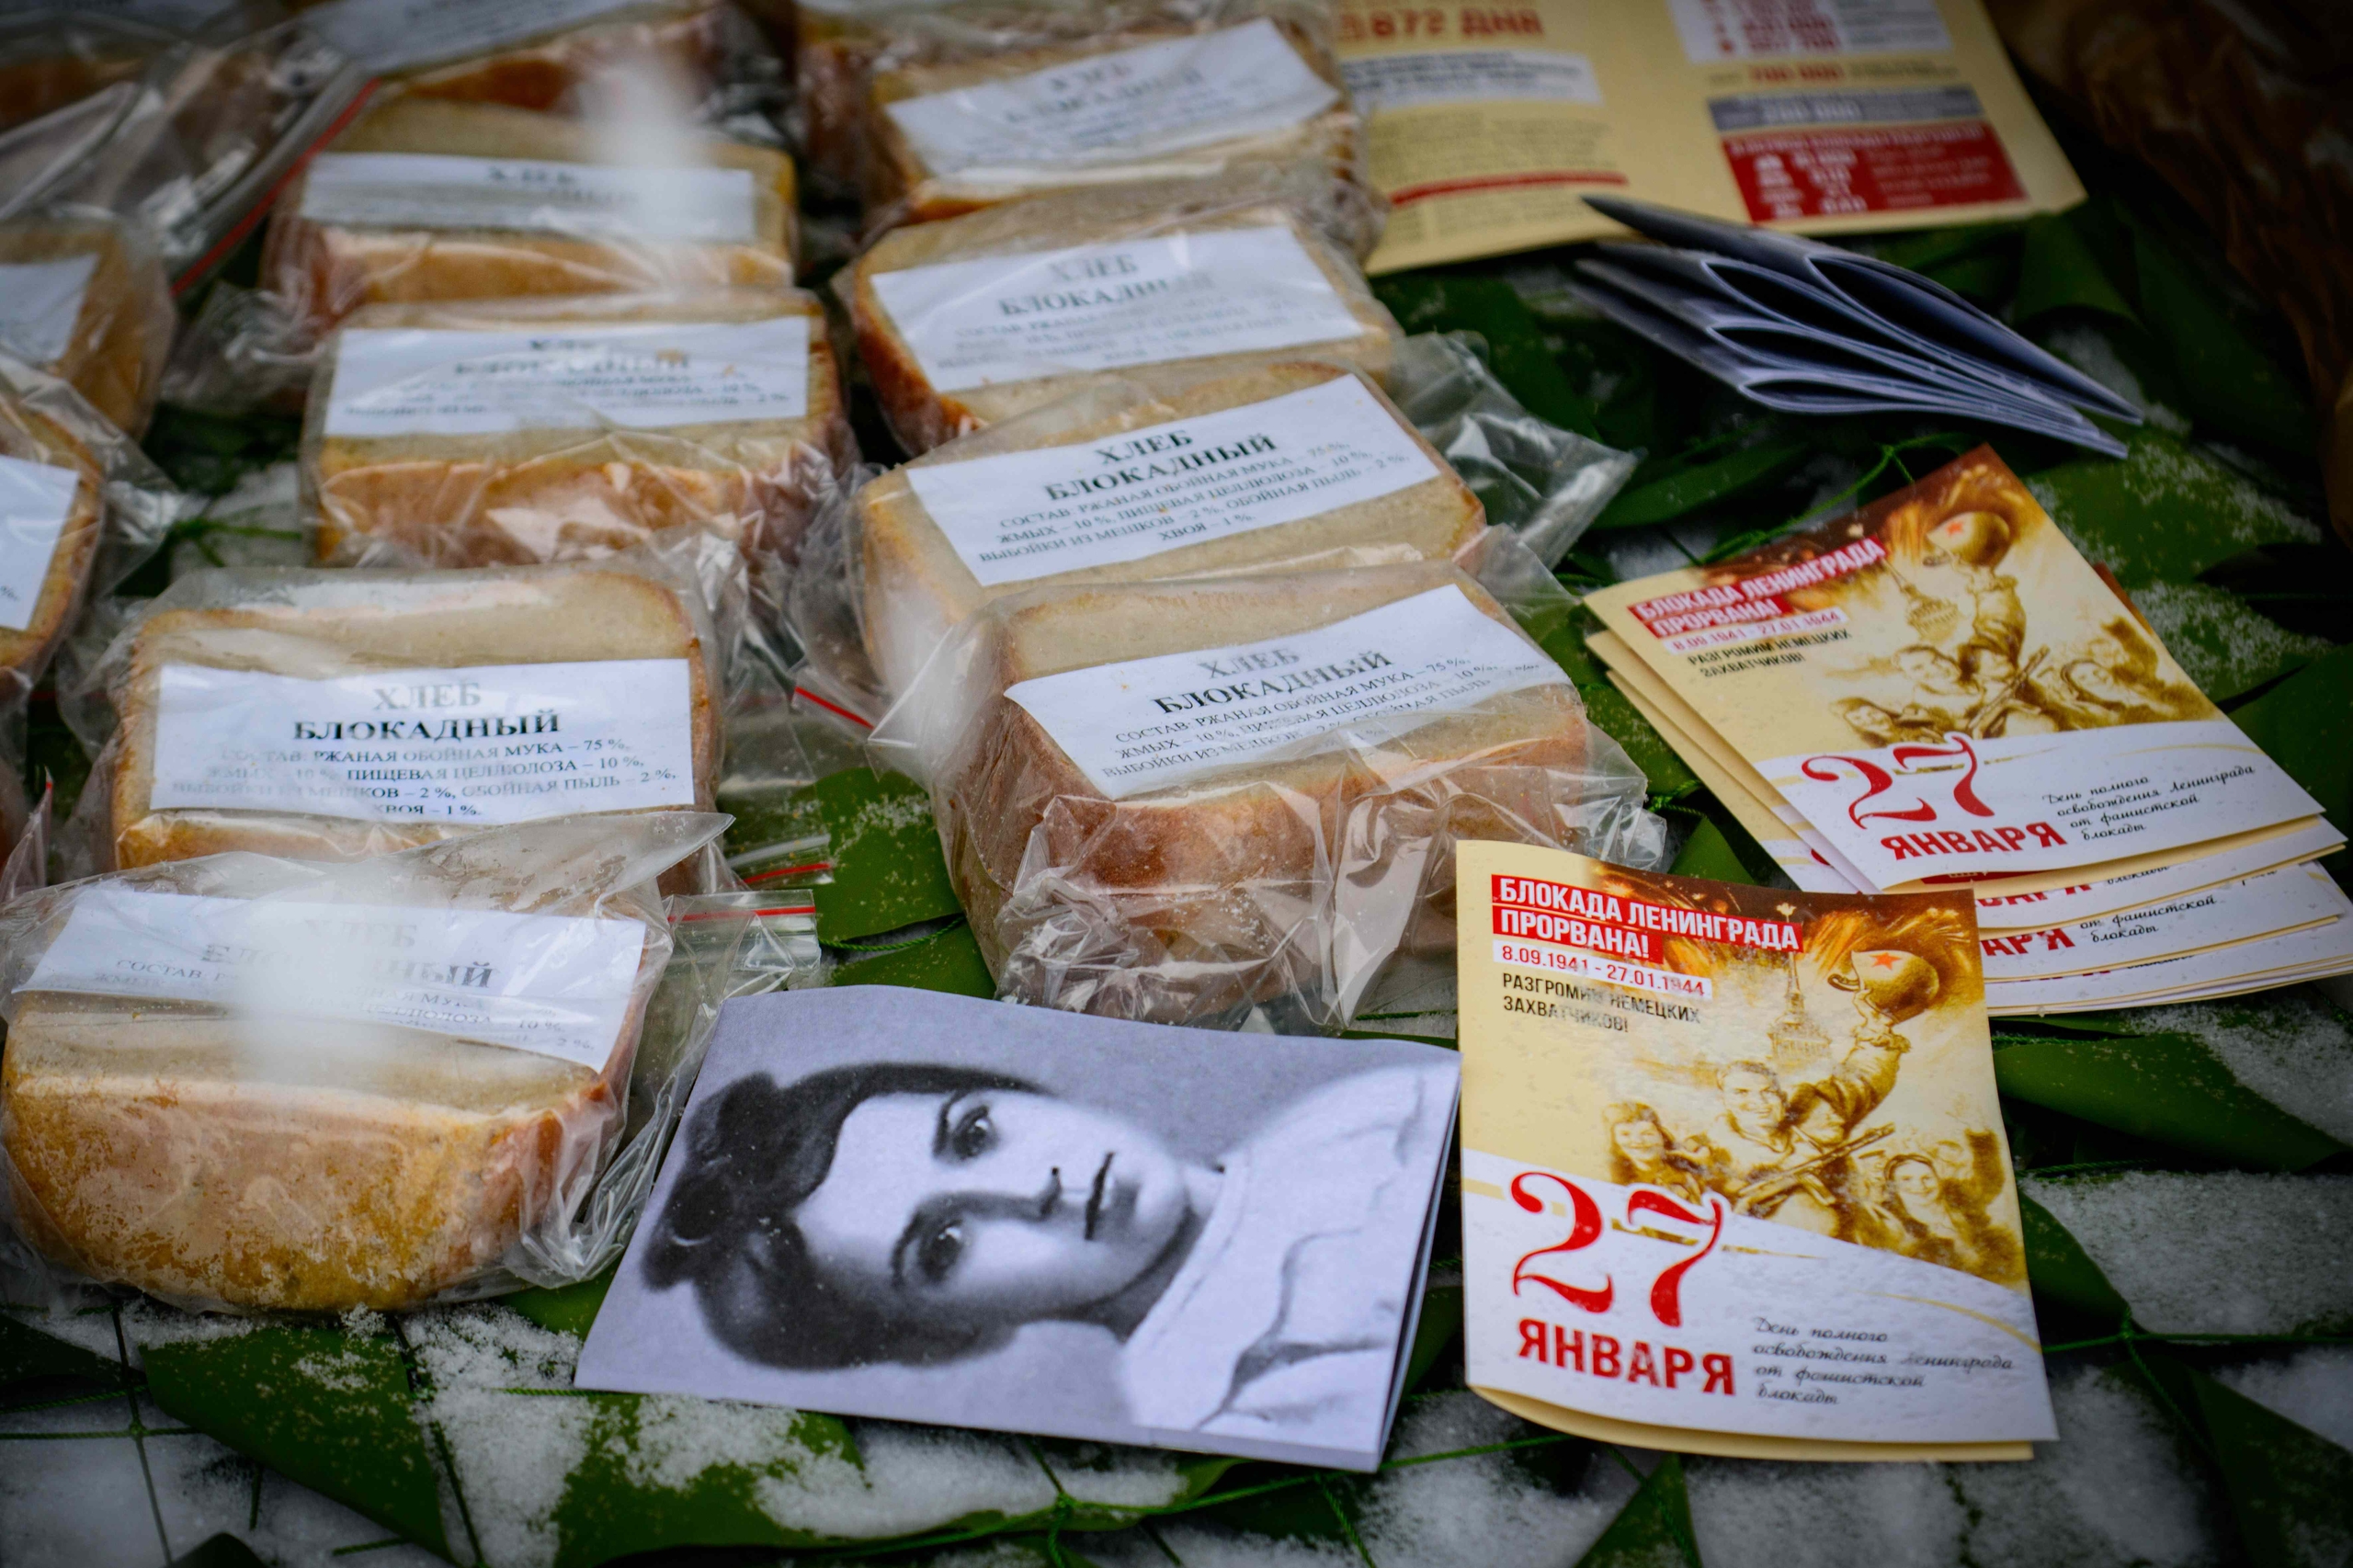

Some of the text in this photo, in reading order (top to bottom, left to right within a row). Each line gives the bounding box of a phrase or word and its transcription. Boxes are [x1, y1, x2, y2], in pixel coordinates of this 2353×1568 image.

[1095, 428, 1194, 466] ХЛЕБ
[1042, 432, 1279, 502] БЛОКАДНЫЙ
[1077, 489, 1153, 513] РЖАНАЯ
[1154, 466, 1241, 496] ОБОЙНАЯ
[1241, 455, 1292, 477] МУКА
[978, 537, 1068, 563] ВЫБОЙКИ
[1071, 533, 1094, 547] ИЗ
[1096, 514, 1176, 540] МЕШКОВ
[1192, 506, 1201, 519] 2
[1226, 481, 1310, 510] ОБОЙНАЯ
[1311, 466, 1362, 489] ПЫЛЬ
[1377, 458, 1389, 471] 2
[996, 526, 1058, 545] ЖМЫХ
[1074, 517, 1093, 530] 10
[1117, 491, 1206, 520] ПИЩЕВАЯ
[1205, 465, 1316, 502] ЦЕЛЛЮЛОЗА
[1330, 454, 1349, 467] 10
[1157, 521, 1209, 543] ХВОЯ
[1223, 517, 1233, 528] 1
[1636, 538, 1885, 621] БЛОКАДА ЛЕНИНГРАДА
[1652, 598, 1782, 637] ПРОРВАНА!
[1196, 648, 1301, 680] ХЛЕБ
[1688, 629, 1853, 666] РАЗГРОМИМ НЕМЕЦКИХ
[1700, 651, 1807, 678] ЗАХВАТЧИКОВ!
[373, 681, 482, 710] ХЛЕБ
[1149, 649, 1394, 714] БЛОКАДНЫЙ
[1195, 704, 1273, 728] РЖАНАЯ
[1273, 684, 1359, 714] ОБОЙНАЯ
[1359, 669, 1414, 693] МУКА
[1427, 660, 1446, 673] 75
[292, 709, 563, 743] БЛОКАДНЫЙ
[1114, 738, 1181, 760] ЖМЫХ
[1195, 731, 1214, 744] 10
[1330, 680, 1441, 717] ЦЕЛЛЮЛОЗА
[1455, 669, 1473, 682] 10
[313, 749, 397, 763] РЖАНАЯ
[403, 746, 498, 763] ОБОЙНАЯ
[505, 742, 563, 757] МУКА
[584, 739, 603, 751] 75
[347, 767, 447, 781] ПИЩЕВАЯ
[454, 759, 578, 780] ЦЕЛЛЮЛОЗА
[599, 757, 618, 769] 10
[1101, 753, 1193, 778] ВЫБОЙКИ
[1194, 745, 1220, 762] ИЗ
[419, 787, 430, 799] 2
[461, 778, 559, 798] ОБОЙНАЯ
[563, 774, 620, 791] ПЫЛЬ
[641, 772, 651, 783] 2
[1801, 735, 1995, 830] 27
[2042, 776, 2151, 805] День полного
[2057, 765, 2256, 817] освобождения Ленинграда
[446, 805, 453, 815] 1
[2070, 792, 2200, 829] от фашистской
[1880, 821, 2069, 861] ЯНВАРЯ
[2082, 823, 2147, 842] блокады
[1499, 877, 1801, 951] БЛОКАДА ЛЕНИНГРАДА
[2080, 919, 2101, 930] от
[2111, 894, 2218, 927] фашистской
[1501, 907, 1650, 960] ПРОРВАНА!
[2091, 924, 2160, 944] блокады
[1501, 945, 1589, 975] 8.09.1941
[1607, 963, 1705, 997] 27.01.1944
[1609, 993, 1702, 1025] НЕМЕЦКИХ
[1510, 1171, 1723, 1328] 27
[1754, 1315, 1889, 1343] День полного
[1517, 1317, 1736, 1396] ЯНВАРЯ
[1752, 1341, 1888, 1365] освобождения
[1755, 1365, 1927, 1388] от фашистской
[1756, 1381, 1839, 1405] блокады
